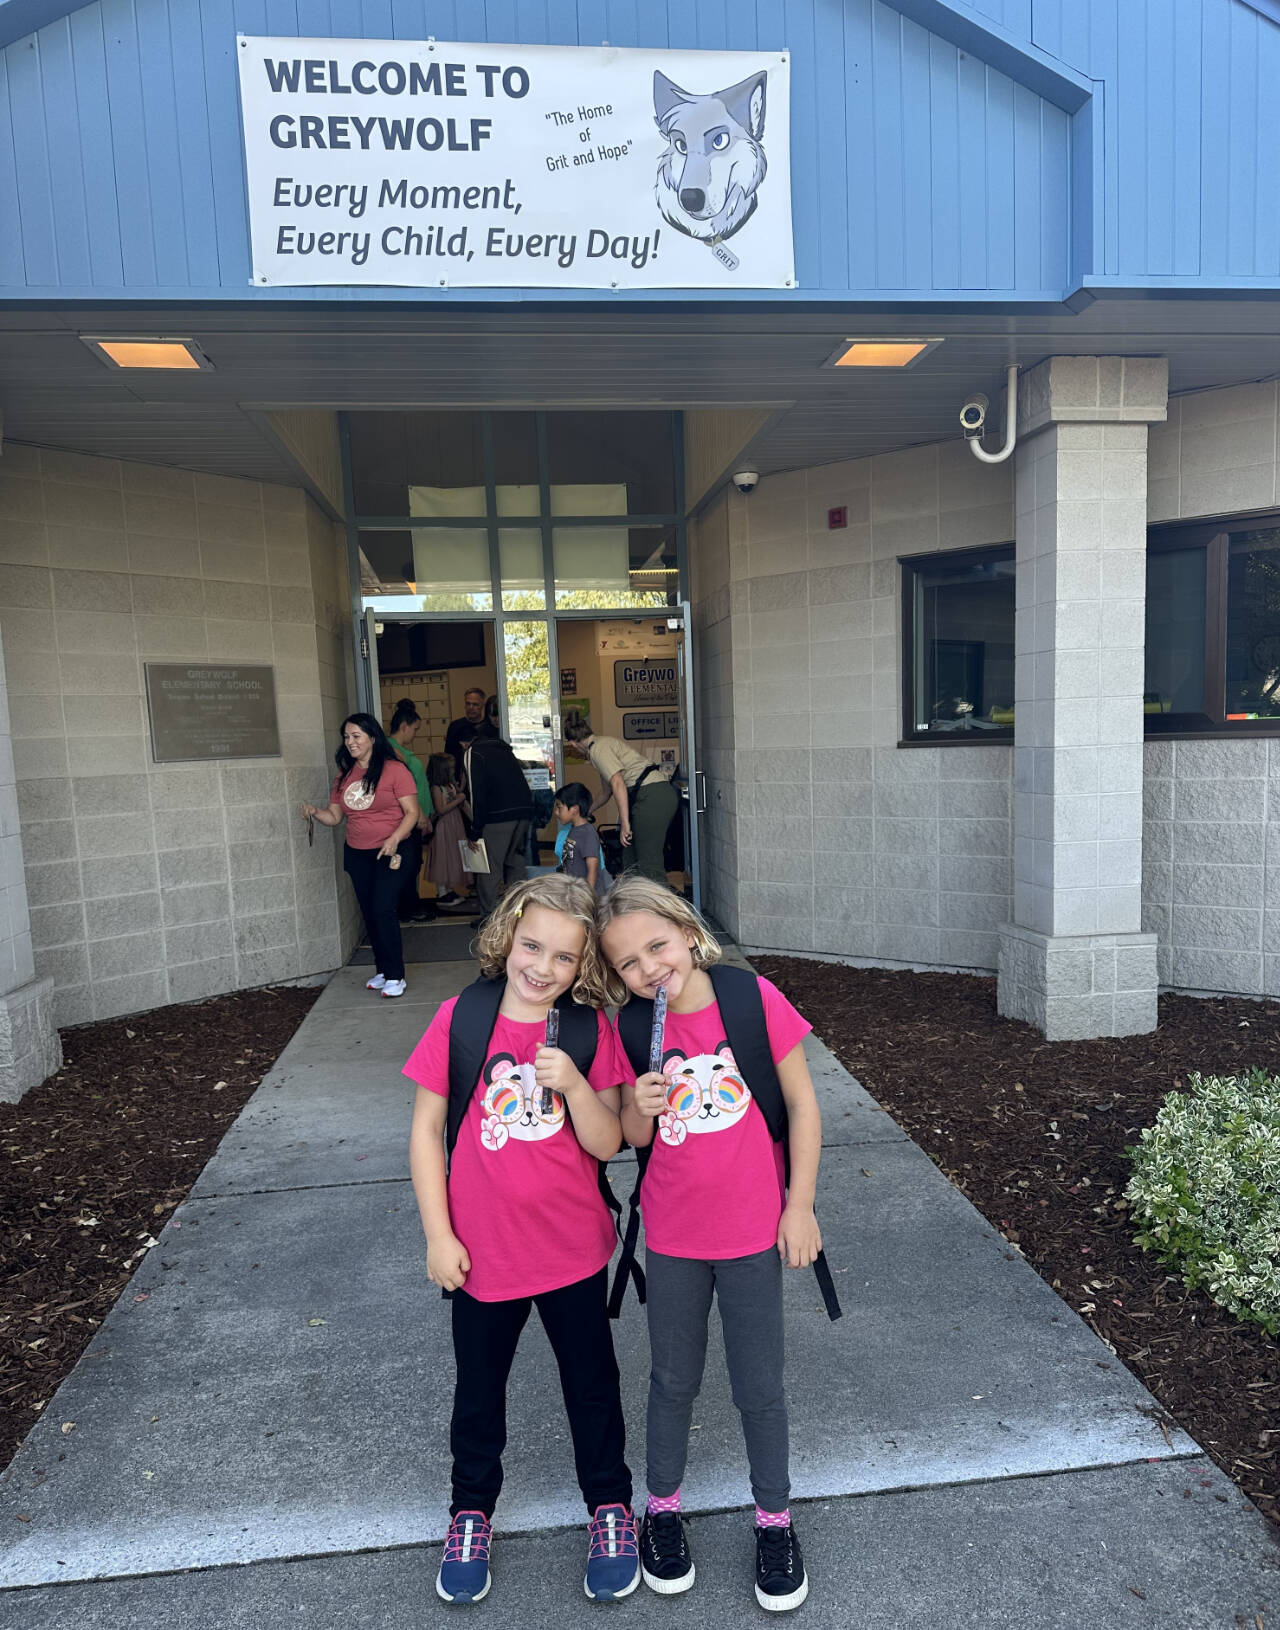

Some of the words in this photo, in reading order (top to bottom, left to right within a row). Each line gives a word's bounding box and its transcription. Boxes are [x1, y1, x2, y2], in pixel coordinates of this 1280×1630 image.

[264, 59, 468, 97] WELCOME
[475, 65, 530, 98] TO
[545, 111, 575, 127] "The
[577, 104, 613, 121] Home
[269, 115, 493, 152] GREYWOLF
[579, 127, 591, 143] of
[546, 154, 570, 172] Grit
[573, 148, 595, 166] and
[597, 139, 633, 161] Hope"
[274, 177, 369, 219] Every
[378, 178, 523, 216] Moment,
[276, 225, 371, 266] Every
[382, 226, 475, 263] Child,
[486, 228, 577, 269] Every
[587, 228, 661, 270] Day!
[716, 248, 736, 268] GRIT
[187, 670, 238, 679] GREYWOLF
[226, 680, 263, 689] SCHOOL
[631, 718, 660, 726] OFFICE
